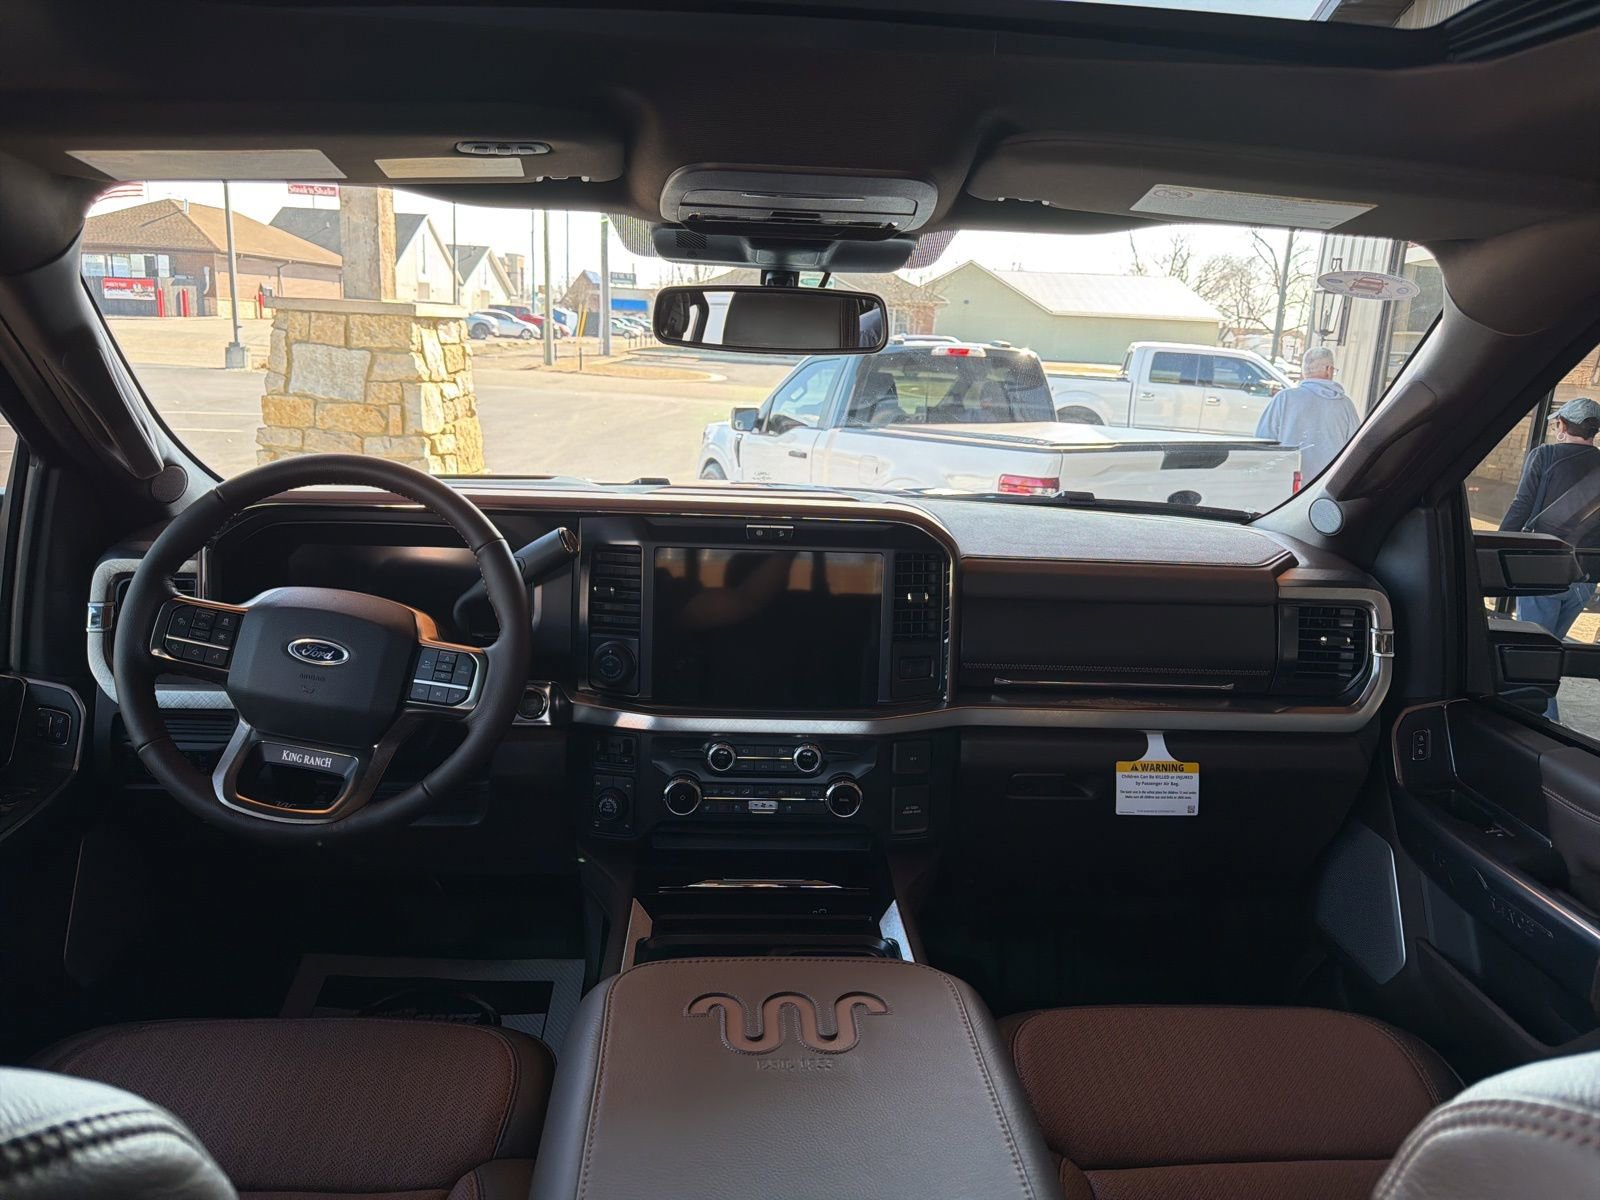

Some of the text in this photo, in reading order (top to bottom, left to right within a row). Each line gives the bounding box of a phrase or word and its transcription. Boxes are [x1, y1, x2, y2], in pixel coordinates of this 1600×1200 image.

[300, 644, 335, 660] Ford
[282, 750, 333, 768] KING RANCH
[1140, 763, 1185, 772] WARNING
